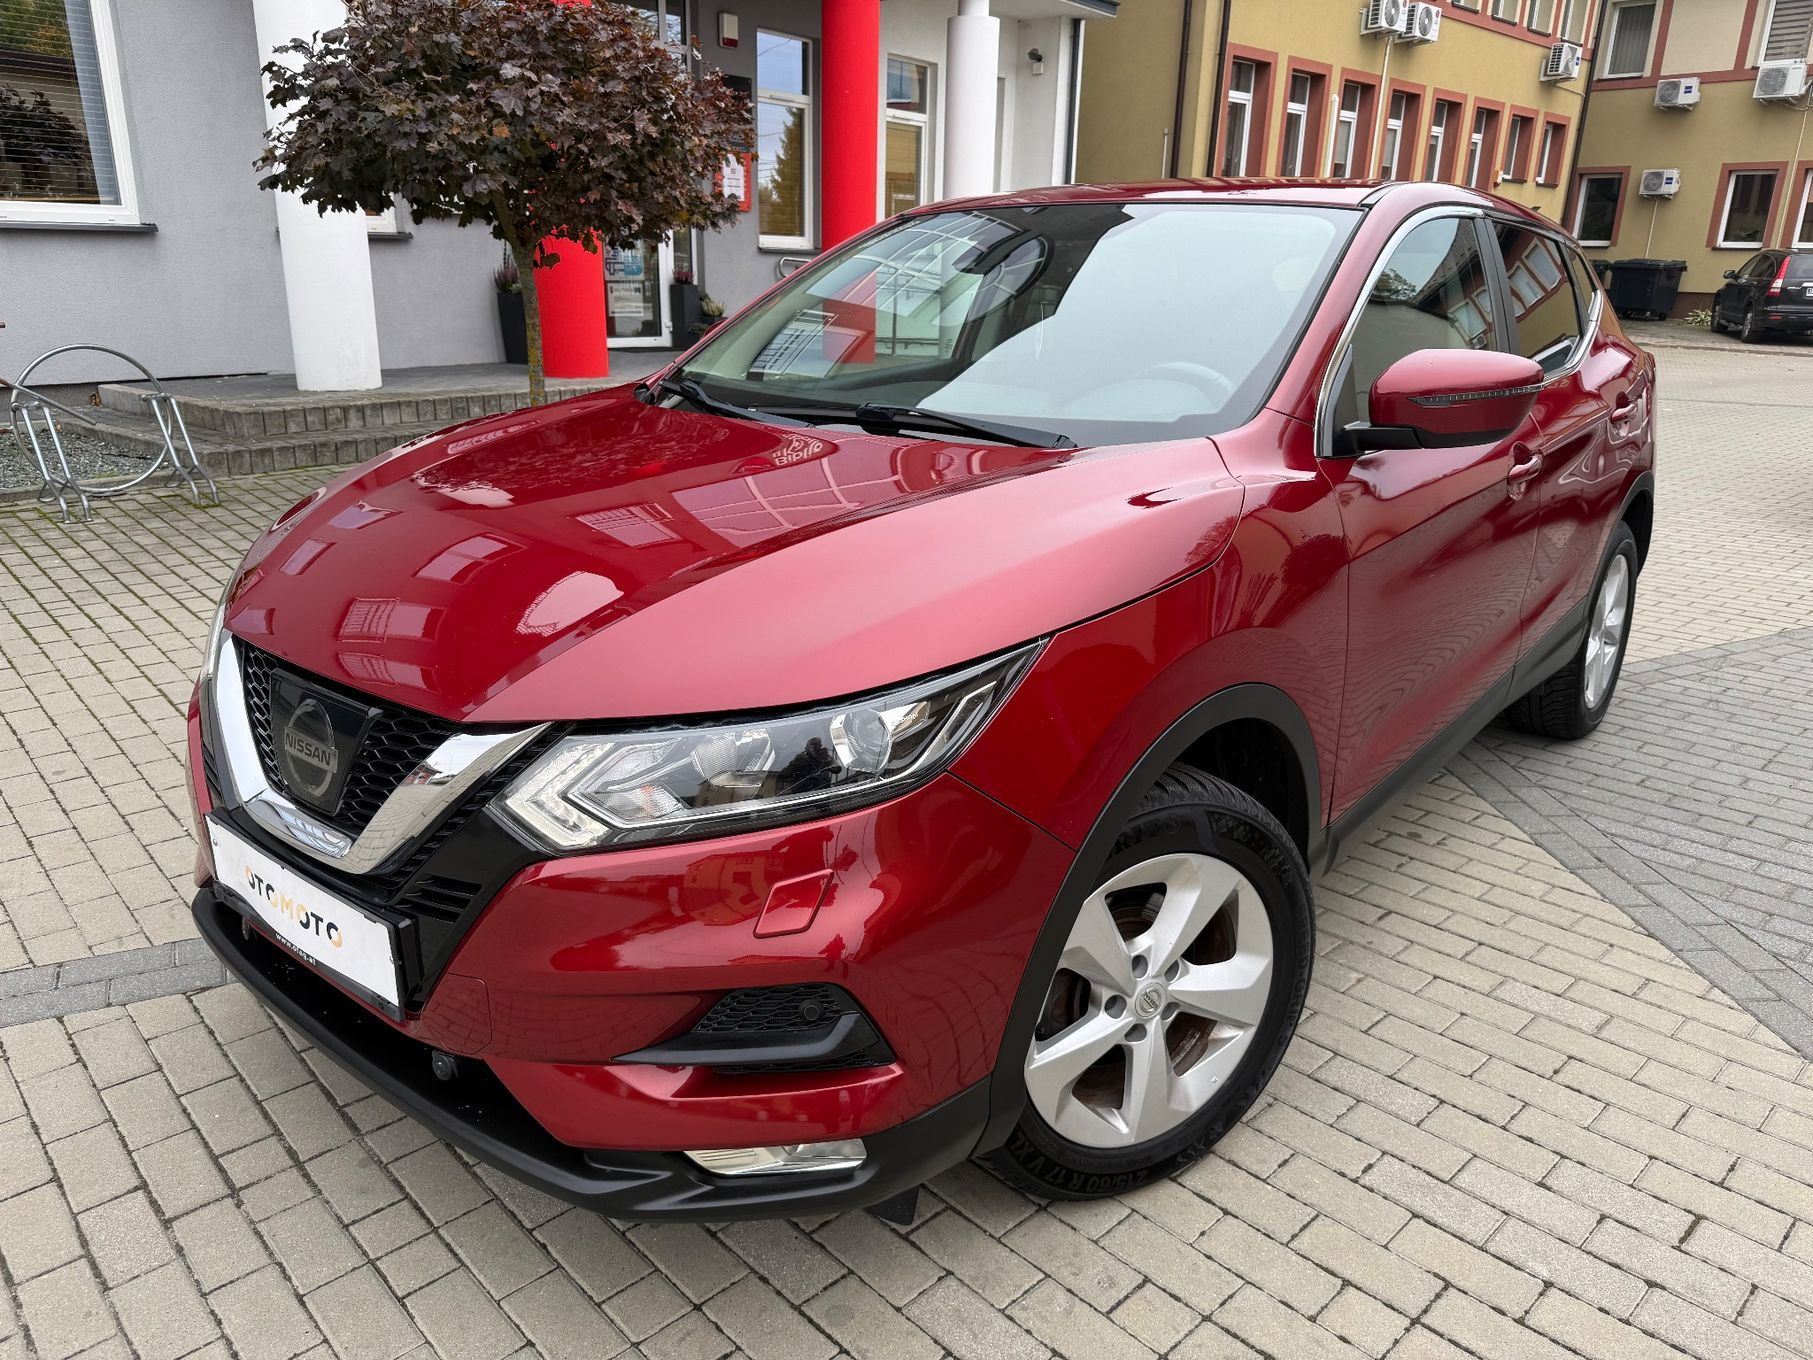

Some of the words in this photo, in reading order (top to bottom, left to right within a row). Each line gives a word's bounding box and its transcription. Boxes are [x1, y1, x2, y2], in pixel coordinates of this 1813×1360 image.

[285, 732, 331, 767] NISSAN
[243, 866, 344, 948] OTOMOTO
[1012, 1133, 1034, 1160] XL
[1027, 1155, 1047, 1173] V
[1046, 1166, 1065, 1186] 17
[1069, 1176, 1085, 1192] R
[1086, 1169, 1150, 1193] 215/60
